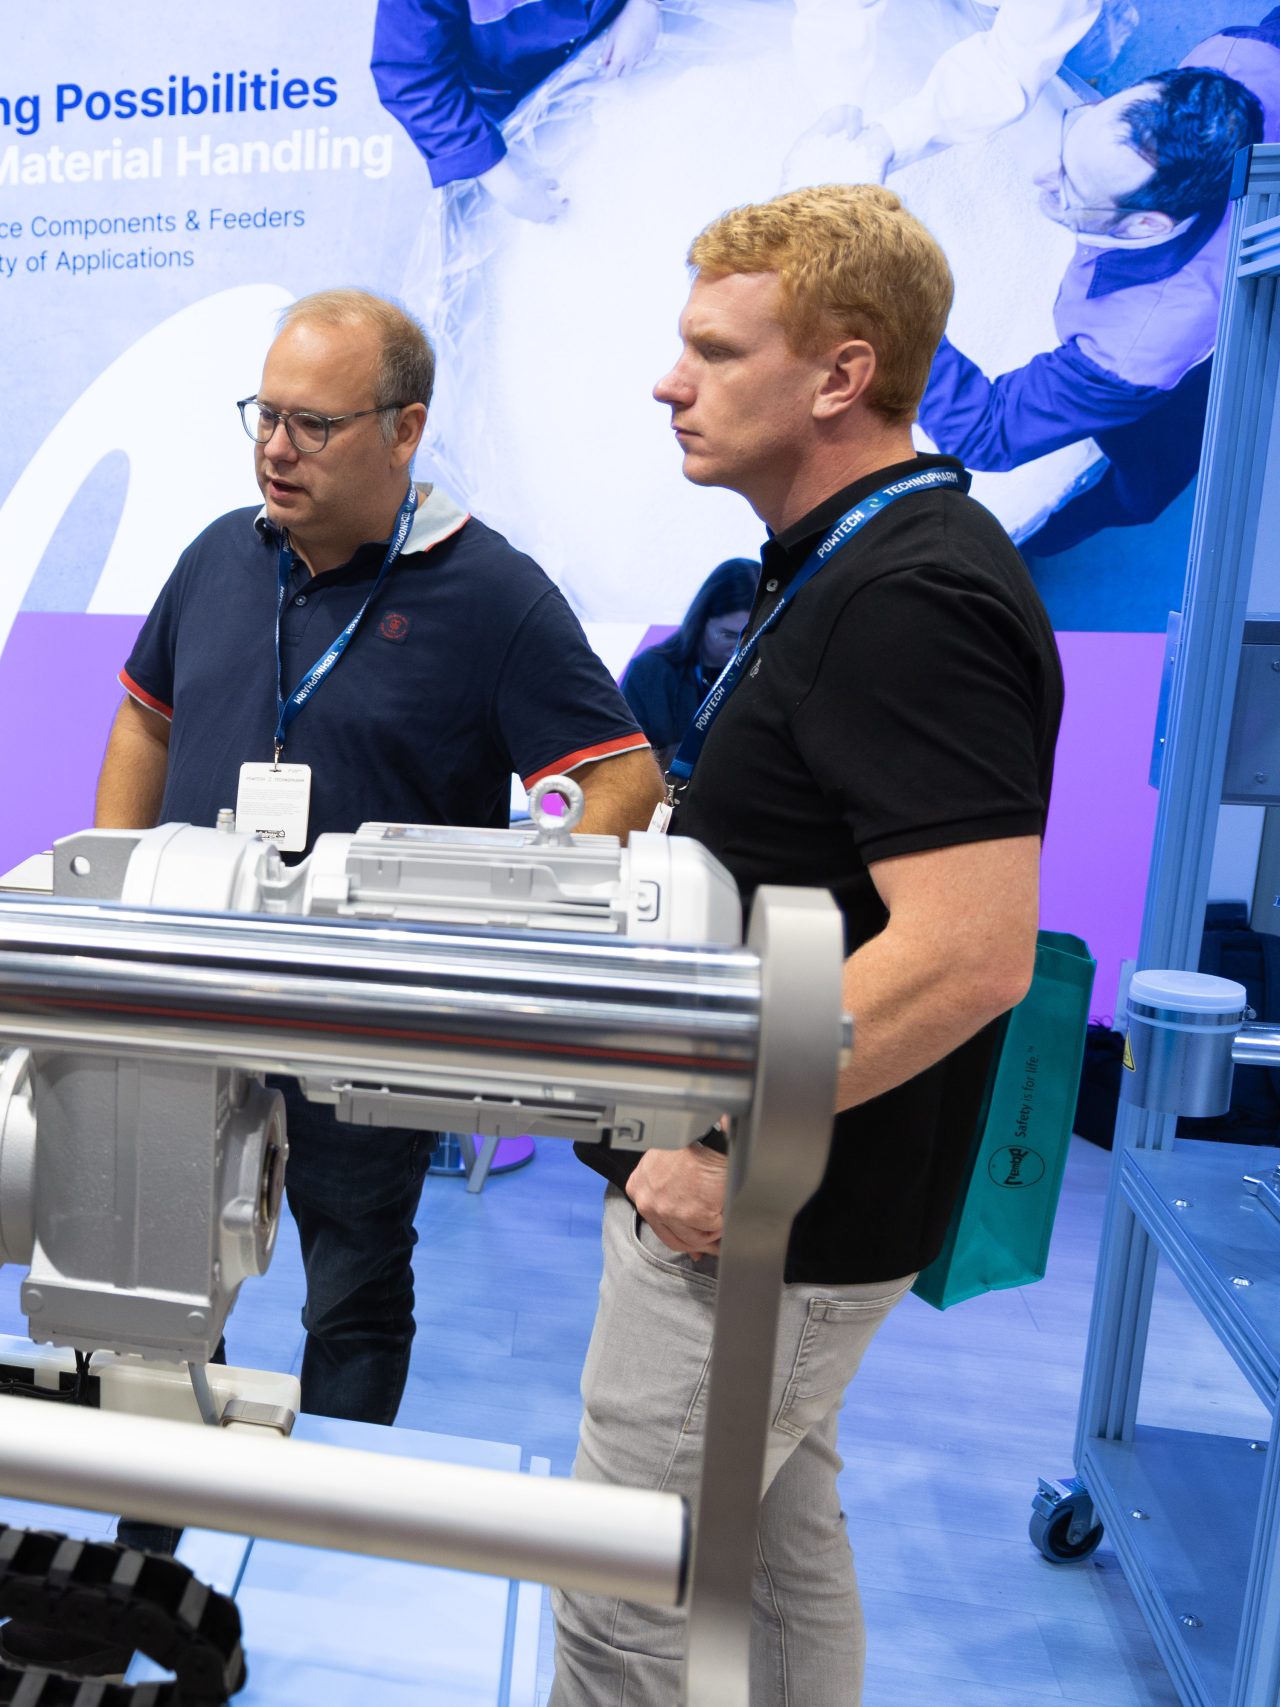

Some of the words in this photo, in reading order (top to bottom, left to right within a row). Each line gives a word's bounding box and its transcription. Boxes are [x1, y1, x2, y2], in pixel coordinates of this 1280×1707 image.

[56, 68, 338, 122] Possibilities
[177, 125, 393, 179] Handling
[31, 212, 176, 240] Components
[185, 209, 200, 232] &
[209, 207, 305, 230] Feeders
[26, 250, 47, 272] of
[56, 246, 194, 276] Applications
[817, 510, 865, 558] POWTECH
[882, 471, 959, 496] TECHNOPHARM
[293, 651, 339, 704] TECHNOPHARM
[695, 686, 726, 731] POWTECH
[1024, 1076, 1035, 1091] for
[1024, 1093, 1033, 1102] is
[1015, 1103, 1033, 1138] Safety
